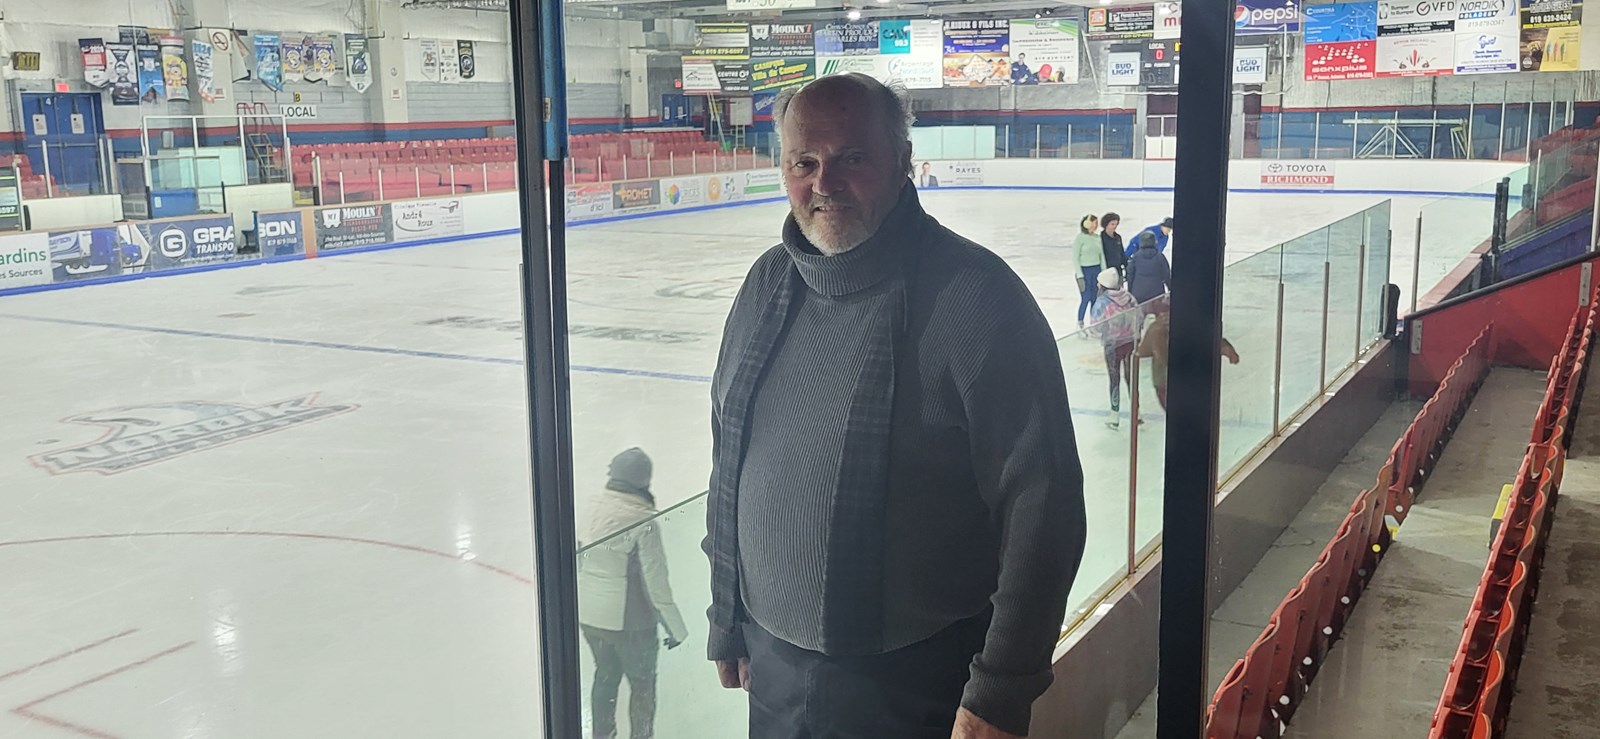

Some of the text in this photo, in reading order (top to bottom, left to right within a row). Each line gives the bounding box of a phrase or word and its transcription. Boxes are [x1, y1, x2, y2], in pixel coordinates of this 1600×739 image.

[1432, 1, 1455, 11] VFD
[1460, 1, 1498, 11] NORDIK
[1251, 4, 1298, 23] pepsi
[770, 24, 812, 34] MOULIN 7
[1155, 50, 1164, 60] 0
[1236, 65, 1261, 73] LIGHT
[281, 106, 316, 117] LOCAL
[1267, 176, 1329, 184] RICHMOND
[342, 205, 383, 219] MOULIN 7
[196, 242, 234, 254] TRANSPO
[9, 269, 43, 278] Sources
